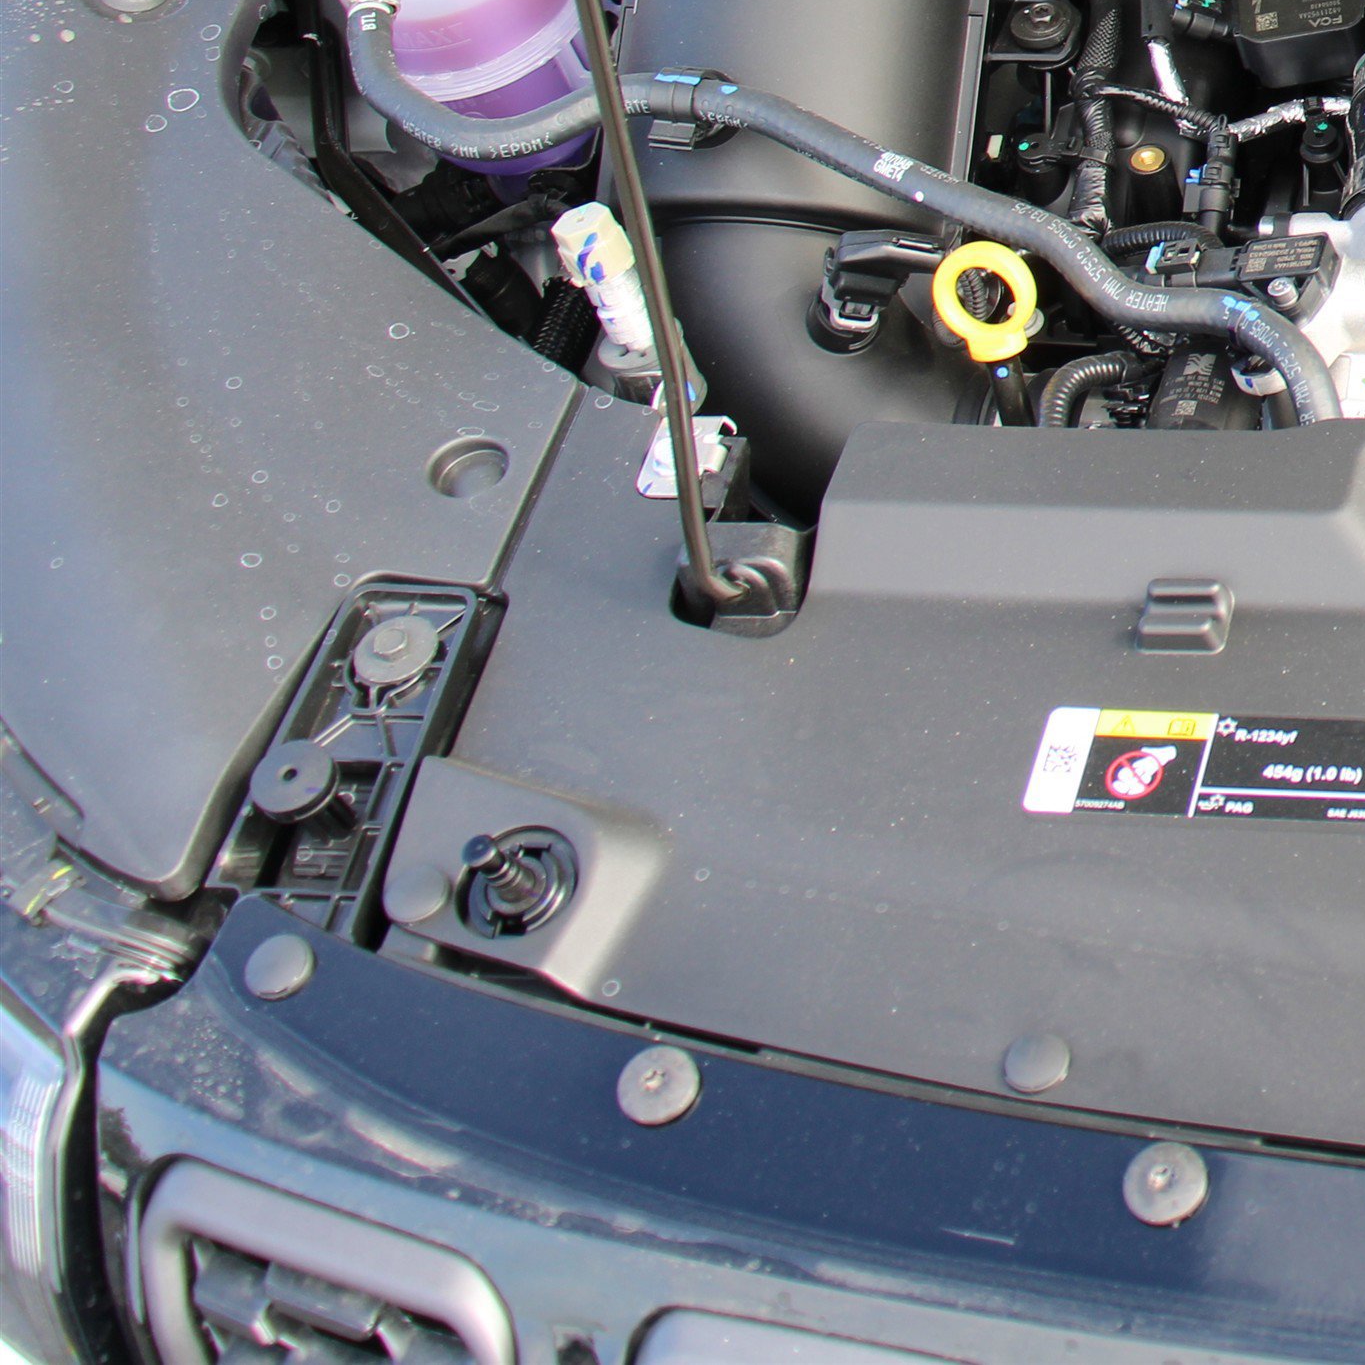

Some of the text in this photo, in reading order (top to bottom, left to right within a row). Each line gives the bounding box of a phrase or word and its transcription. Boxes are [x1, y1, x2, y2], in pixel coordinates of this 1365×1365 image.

[360, 11, 378, 32] BTL
[1307, 13, 1343, 28] FCA
[401, 119, 444, 153] HEATER
[1102, 282, 1128, 302] 7MM
[1125, 291, 1170, 313] HEATER
[1234, 727, 1298, 746] R-1234yf
[1262, 763, 1363, 785] 454g (1.0 lb)
[1224, 800, 1254, 815] PAG
[1326, 807, 1347, 818] SAE
